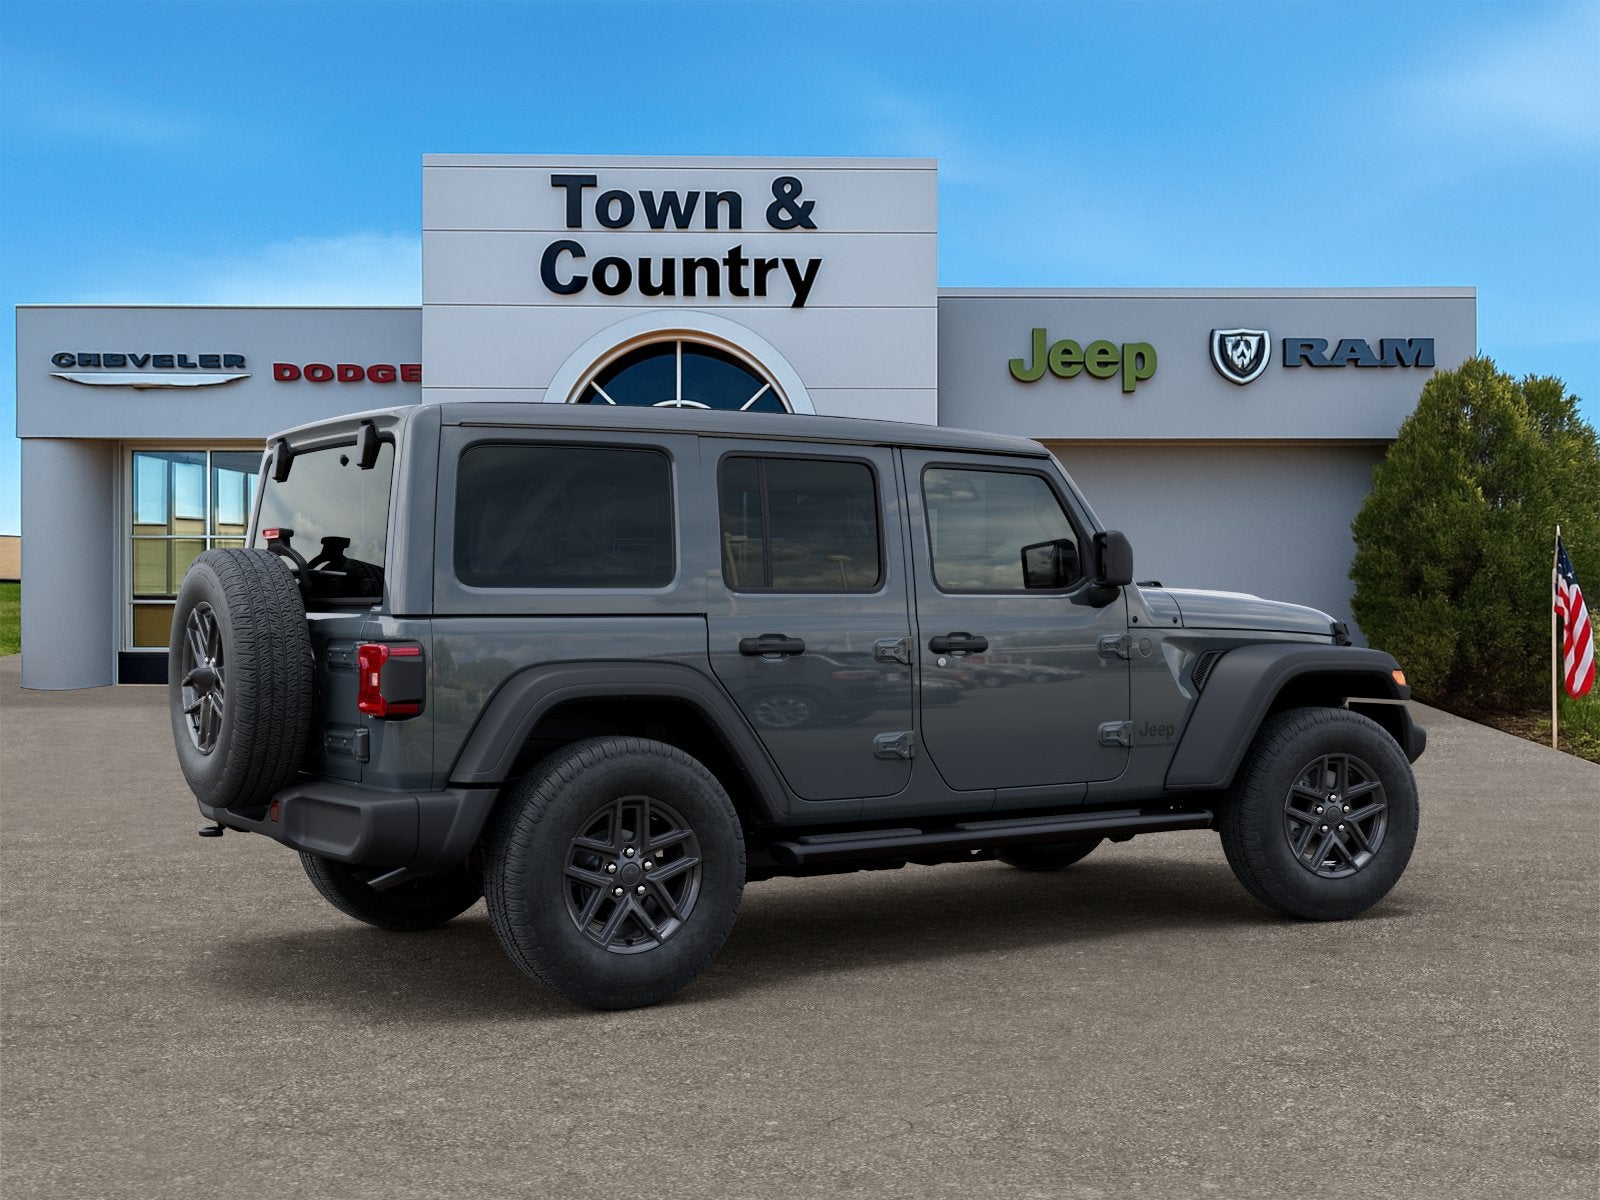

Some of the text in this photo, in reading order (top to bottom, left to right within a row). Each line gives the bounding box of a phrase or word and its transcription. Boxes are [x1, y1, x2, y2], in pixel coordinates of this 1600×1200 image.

[551, 174, 818, 230] Town &
[540, 239, 822, 308] Country
[272, 362, 422, 383] DODGE
[1008, 327, 1157, 392] Jeep
[1282, 337, 1435, 368] RAM
[1138, 720, 1175, 739] Jeep
